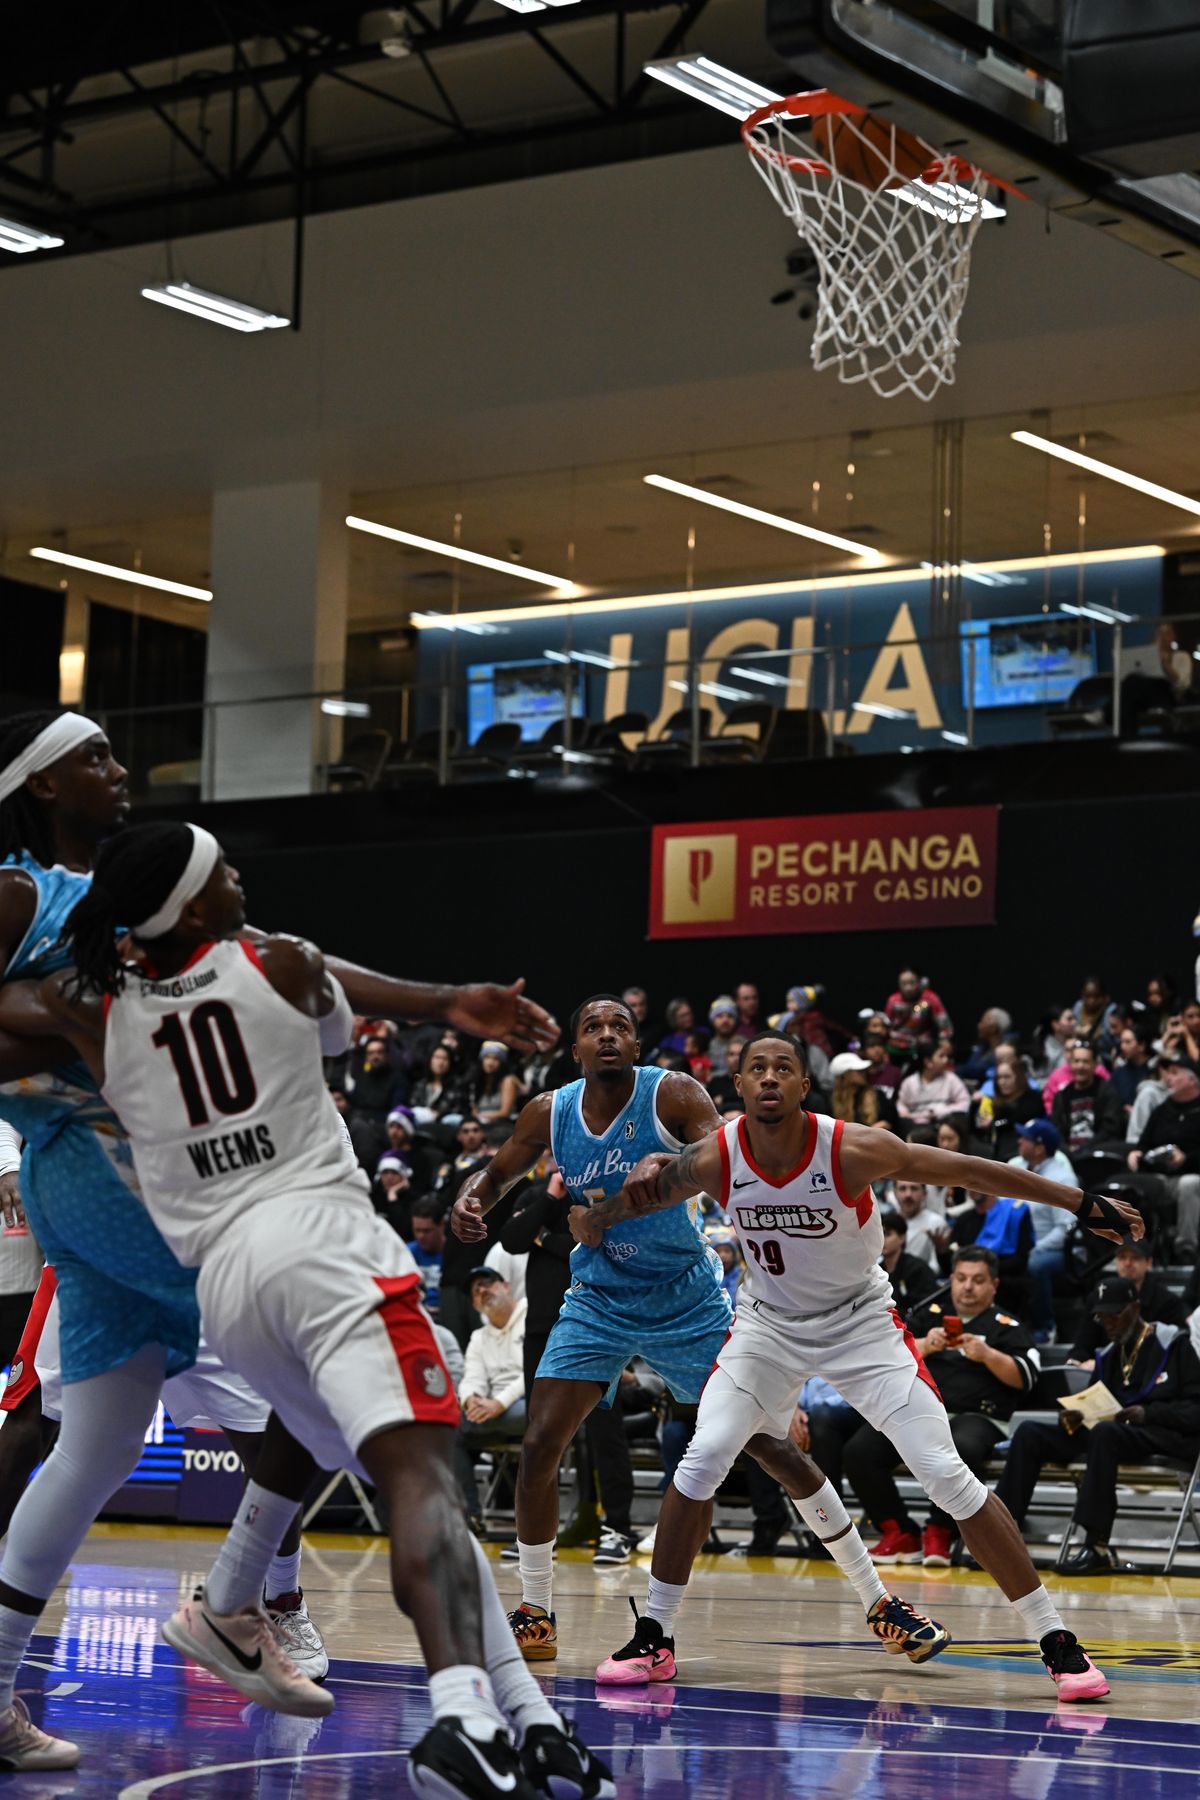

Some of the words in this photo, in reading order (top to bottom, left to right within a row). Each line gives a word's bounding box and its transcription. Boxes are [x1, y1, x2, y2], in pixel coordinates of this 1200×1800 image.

[603, 602, 943, 751] UCLA
[752, 834, 980, 879] PECHANGA
[750, 881, 857, 907] RESORT
[874, 875, 983, 902] CASINO
[151, 999, 257, 1128] 10
[186, 1124, 276, 1179] WEEMS
[603, 1148, 638, 1176] Ba
[736, 1206, 838, 1239] Remix
[182, 1449, 245, 1472] TOYO
